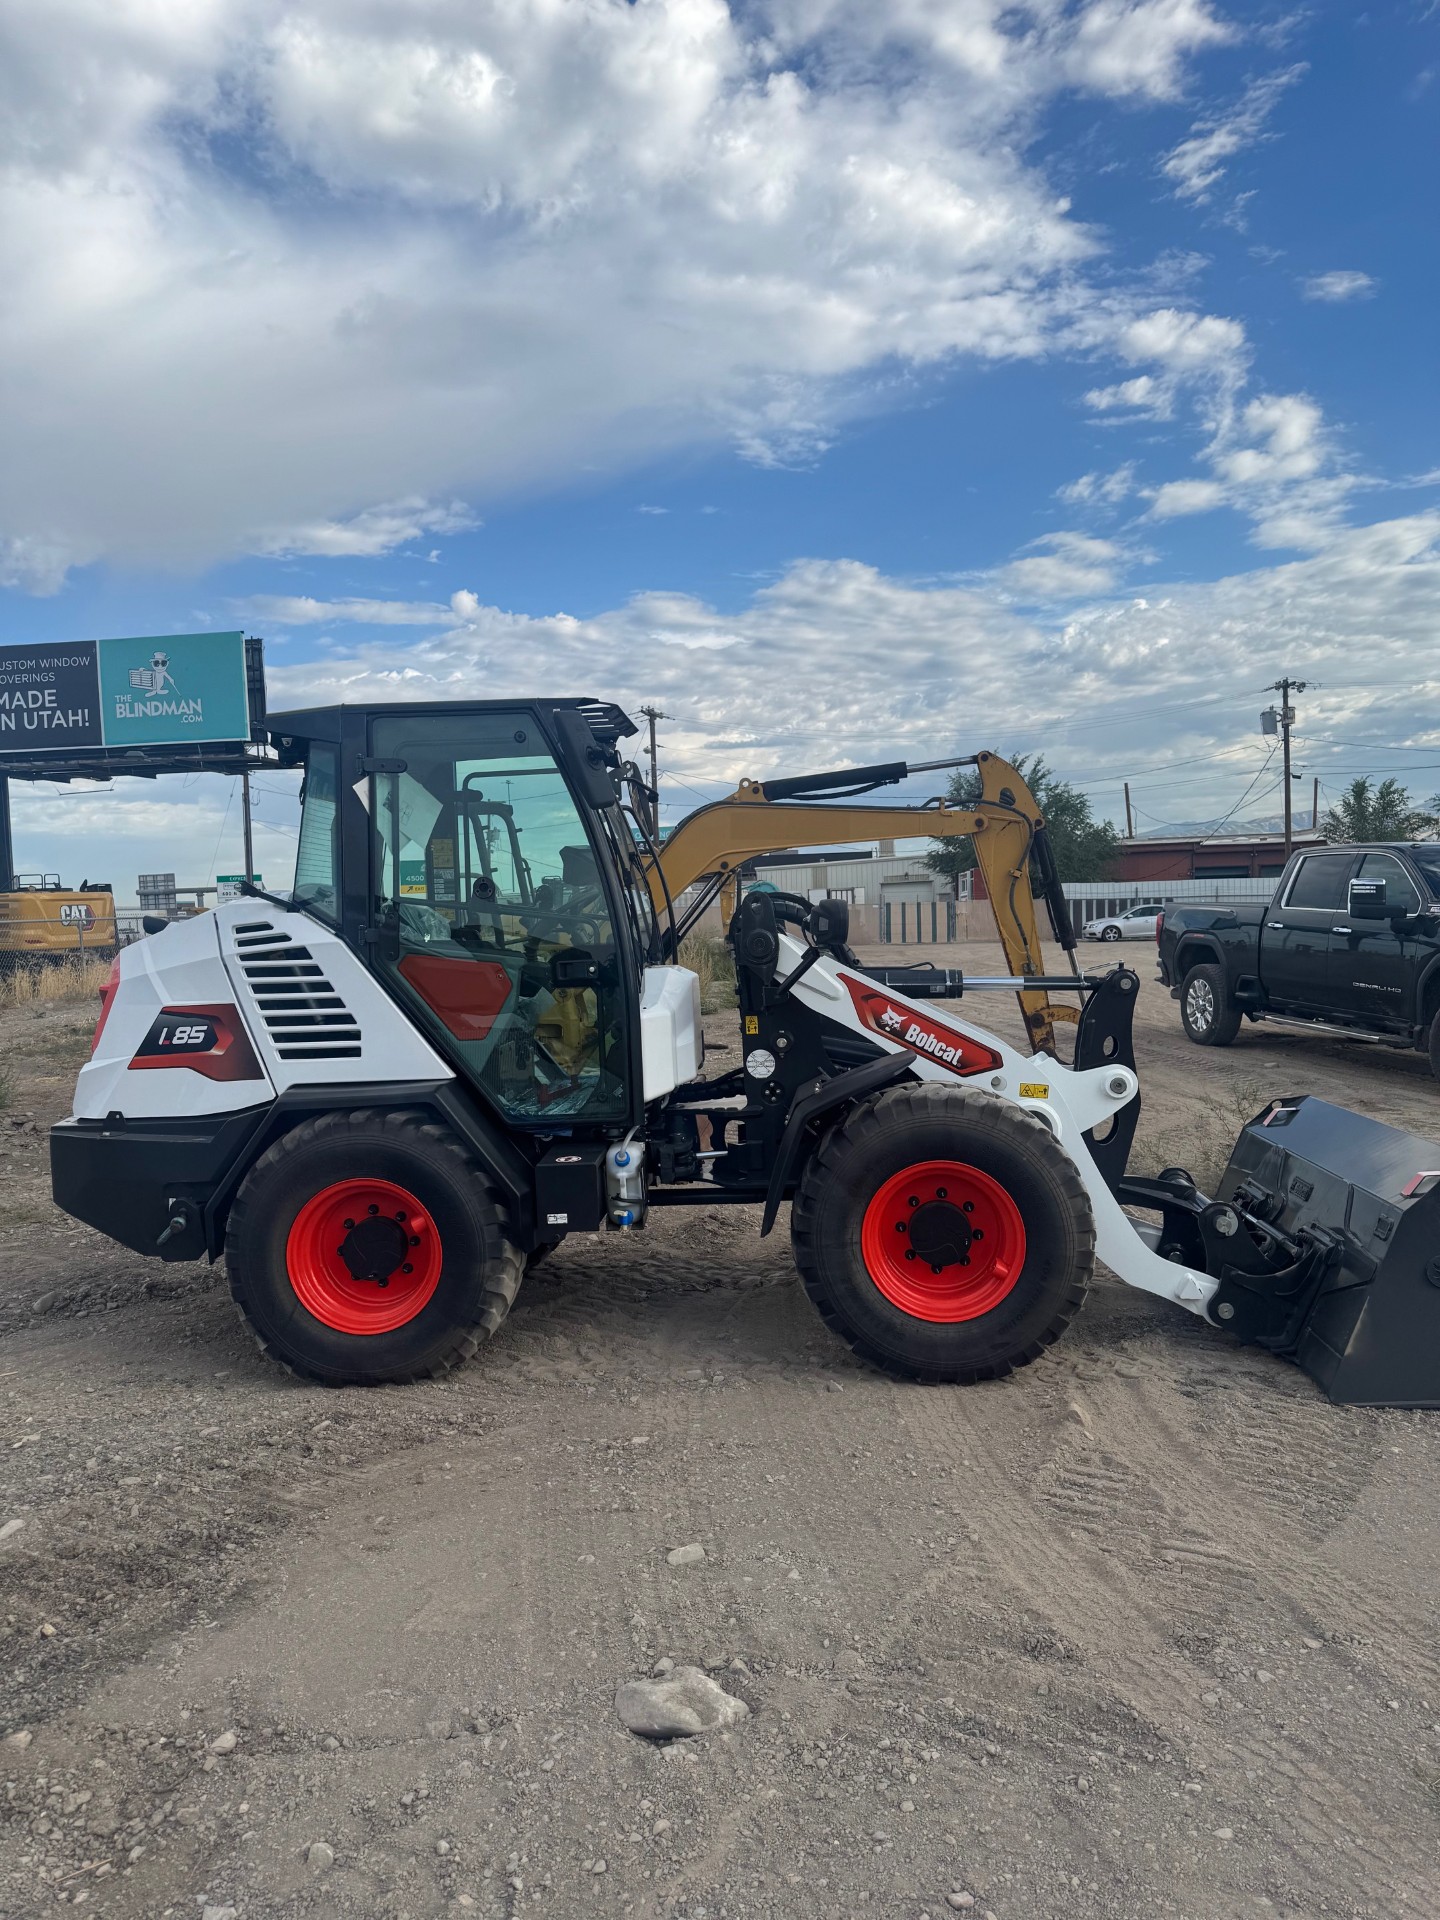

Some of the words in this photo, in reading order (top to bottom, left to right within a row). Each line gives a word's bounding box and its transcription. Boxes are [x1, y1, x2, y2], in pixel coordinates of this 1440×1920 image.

[40, 656, 90, 668] WINDOW
[0, 672, 55, 684] OVERINGS
[115, 694, 132, 702] THE
[116, 698, 202, 718] BLINDMAN
[23, 708, 90, 730] UTAH!
[181, 715, 203, 723] .COM
[60, 905, 87, 926] CAT
[1352, 981, 1387, 991] DENALI
[158, 1025, 208, 1045] L85
[904, 1023, 963, 1066] Bobcat
